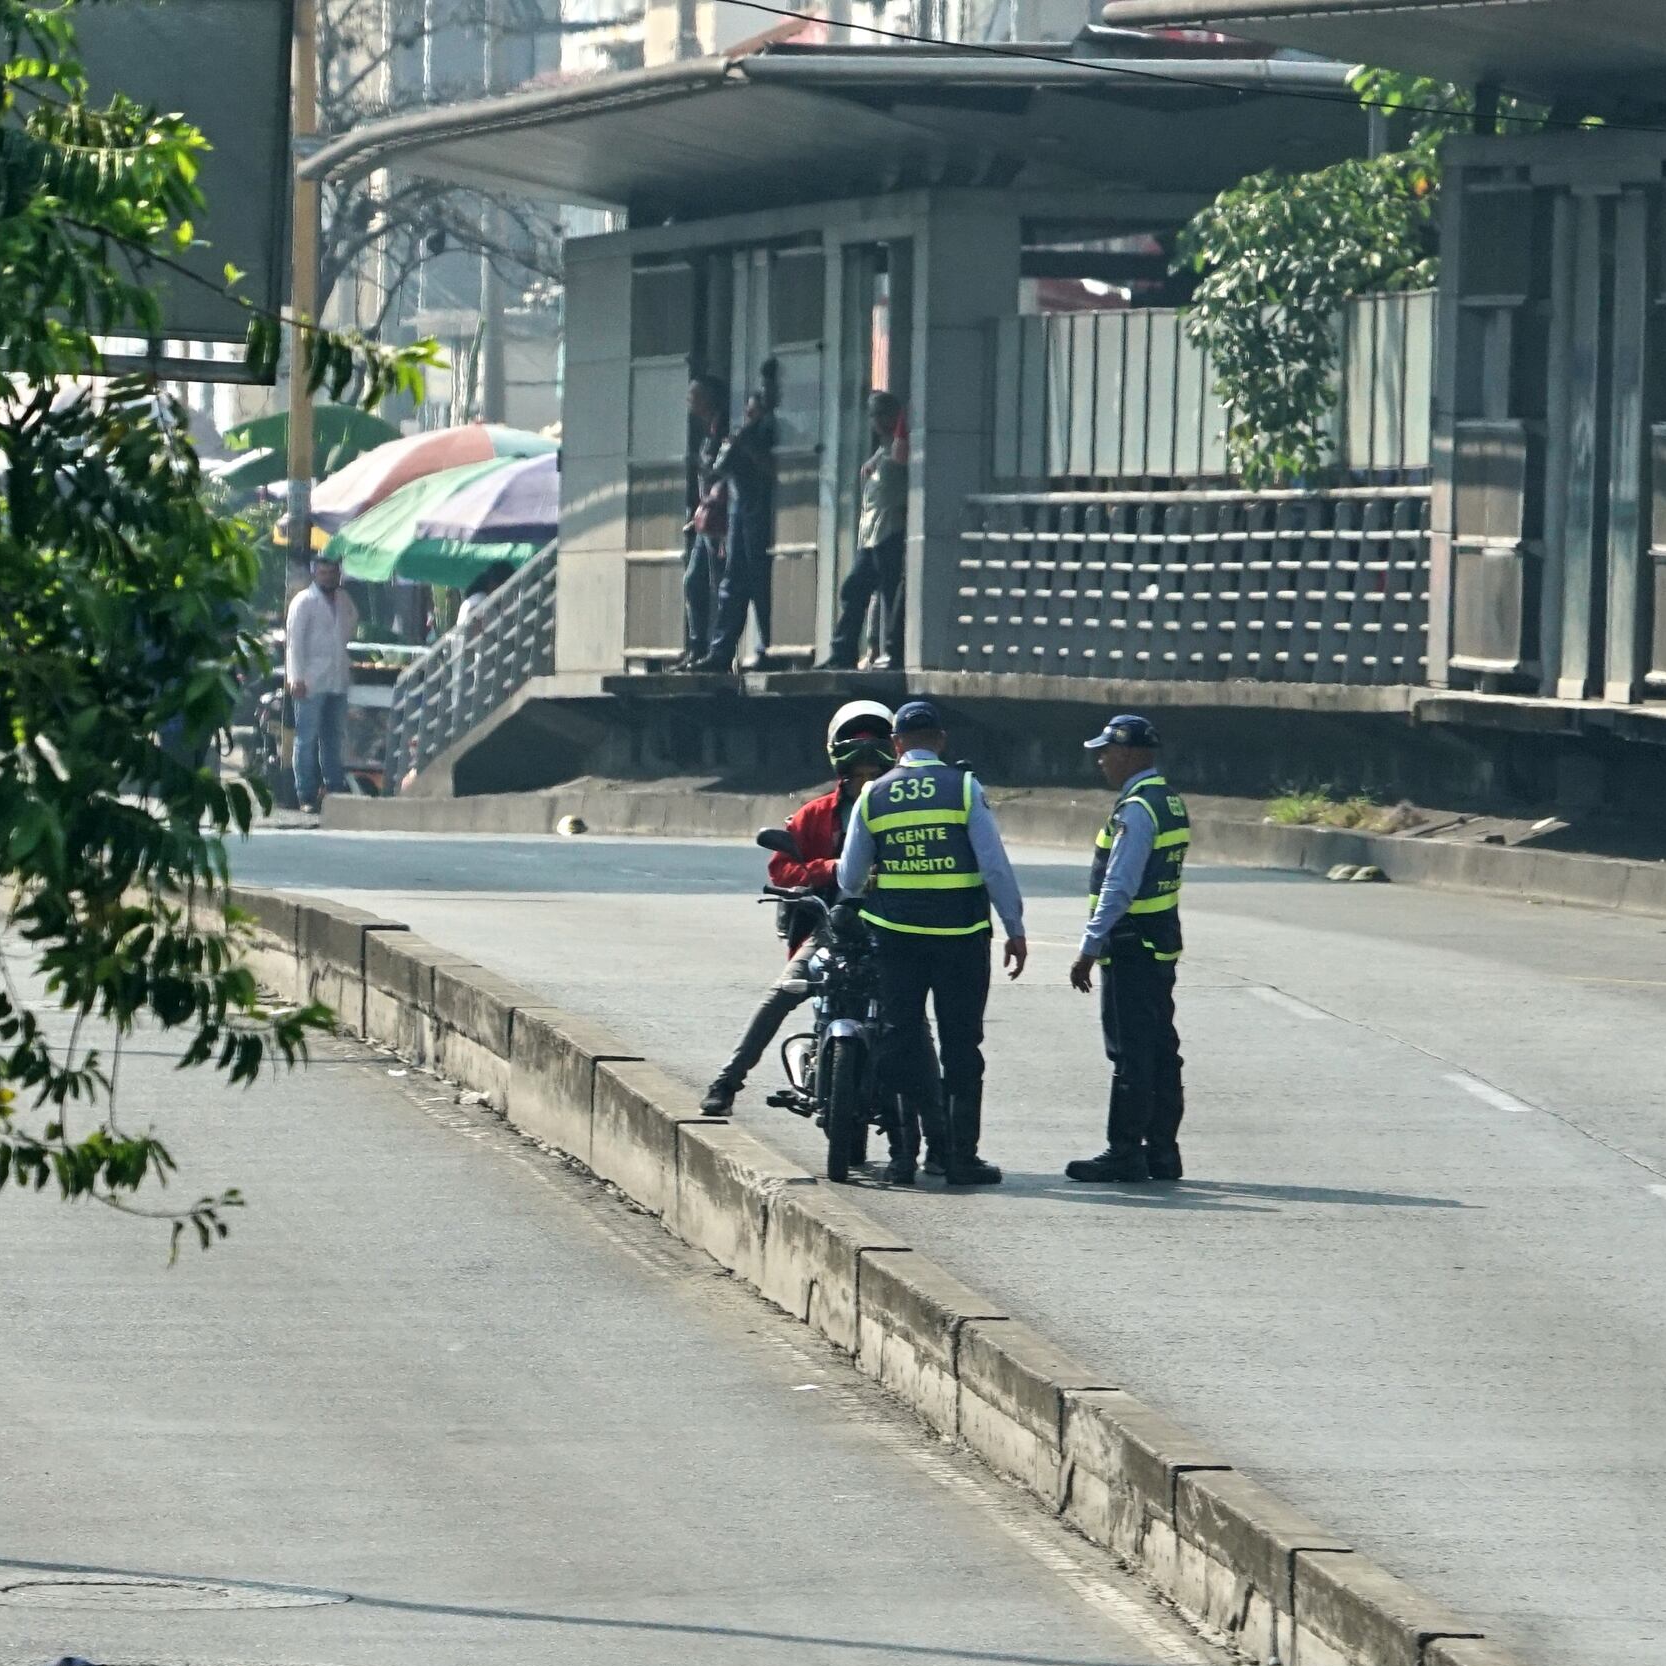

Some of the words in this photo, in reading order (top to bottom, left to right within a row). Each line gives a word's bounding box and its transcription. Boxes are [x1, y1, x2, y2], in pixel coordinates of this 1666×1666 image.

[889, 777, 936, 803] 535
[886, 827, 948, 845] AGENTE
[905, 844, 926, 857] DE
[884, 856, 956, 872] TRANSITO
